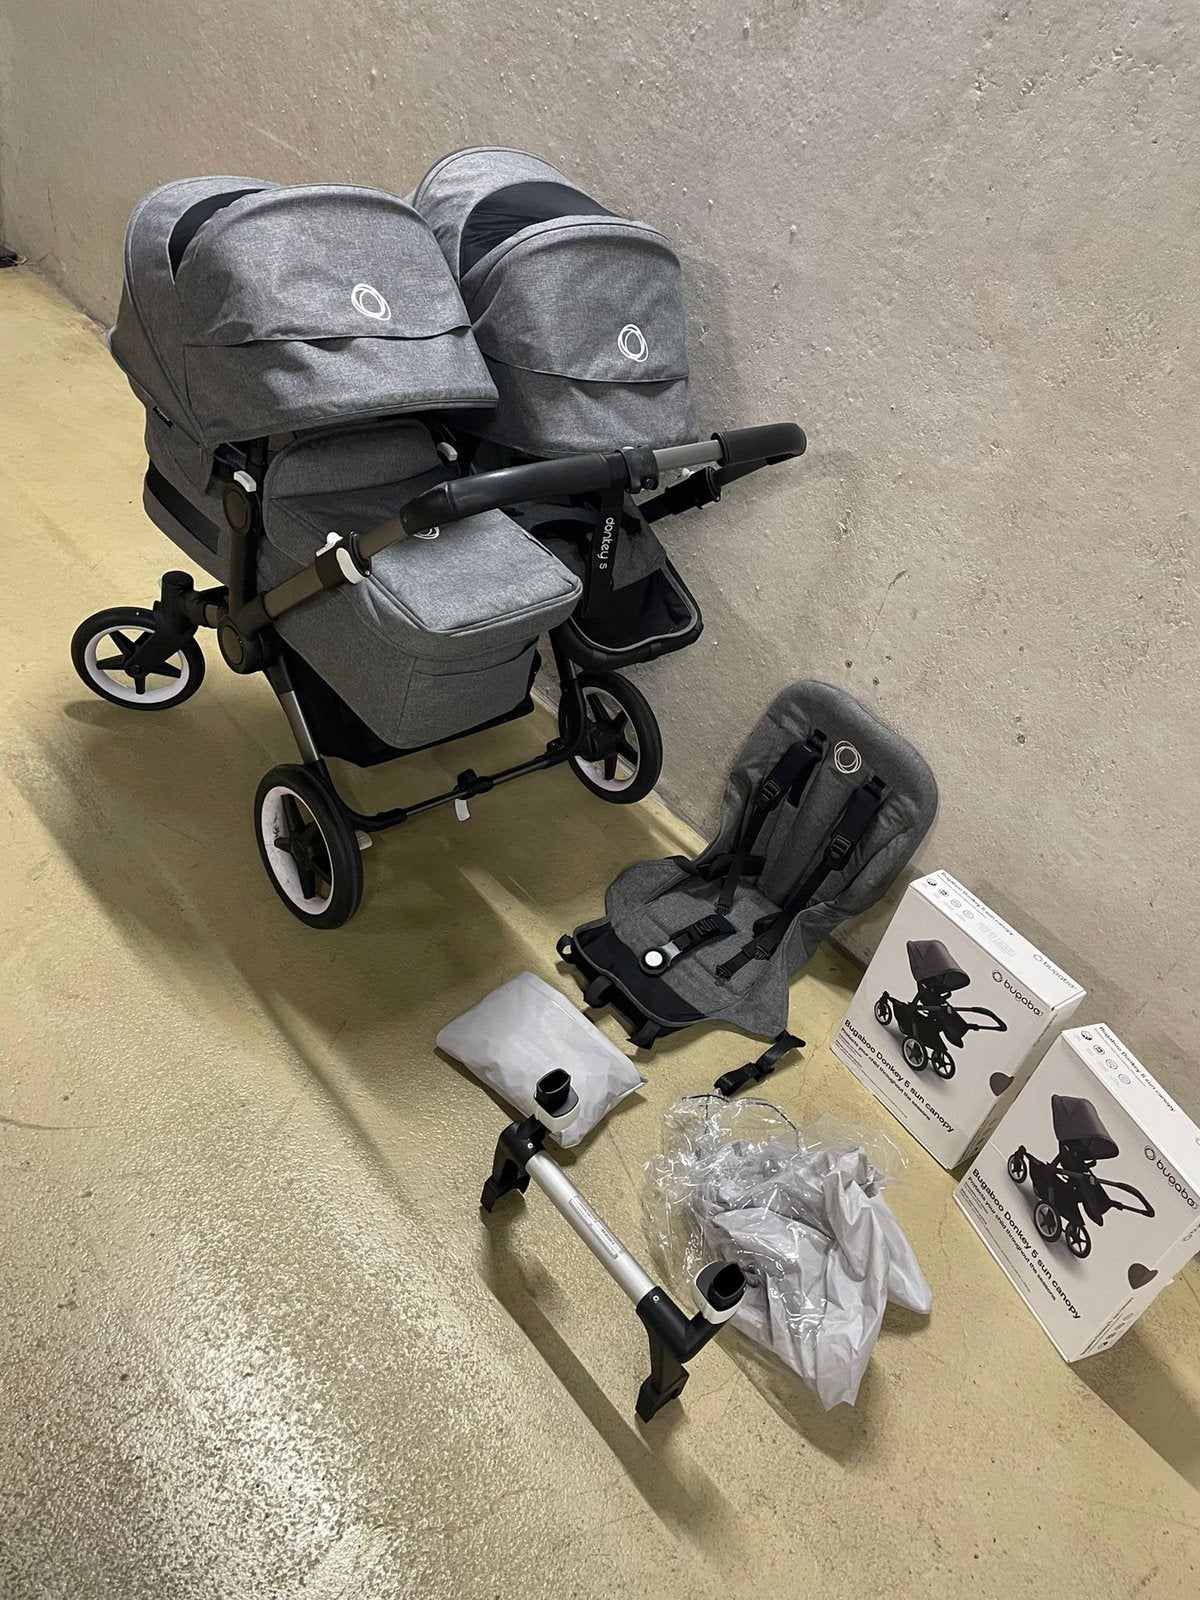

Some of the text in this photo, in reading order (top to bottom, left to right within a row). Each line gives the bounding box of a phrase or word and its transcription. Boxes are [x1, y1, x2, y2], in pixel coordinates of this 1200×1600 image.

[597, 517, 615, 559] donkey
[841, 1027, 859, 1048] Protects
[858, 1047, 869, 1057] your
[868, 1056, 880, 1068] child
[879, 1067, 904, 1093] throughout
[903, 1092, 912, 1101] the
[911, 1100, 931, 1121] seasons
[844, 1019, 876, 1054] Bugaboo
[876, 1051, 904, 1082] Donkey
[903, 1080, 911, 1088] 5
[910, 1087, 925, 1104] sun
[925, 1102, 955, 1133] canopy
[967, 1176, 986, 1201] Protects
[985, 1201, 996, 1214] your
[995, 1214, 1006, 1230] child
[1005, 1229, 1030, 1263] throughout
[1029, 1262, 1038, 1274] the
[1036, 1273, 1057, 1301] seasons
[972, 1168, 1004, 1212] Bugaboo
[1004, 1210, 1032, 1250] Donkey
[1031, 1249, 1039, 1259] 5
[1037, 1259, 1052, 1280] sun
[1051, 1279, 1081, 1320] canopy
